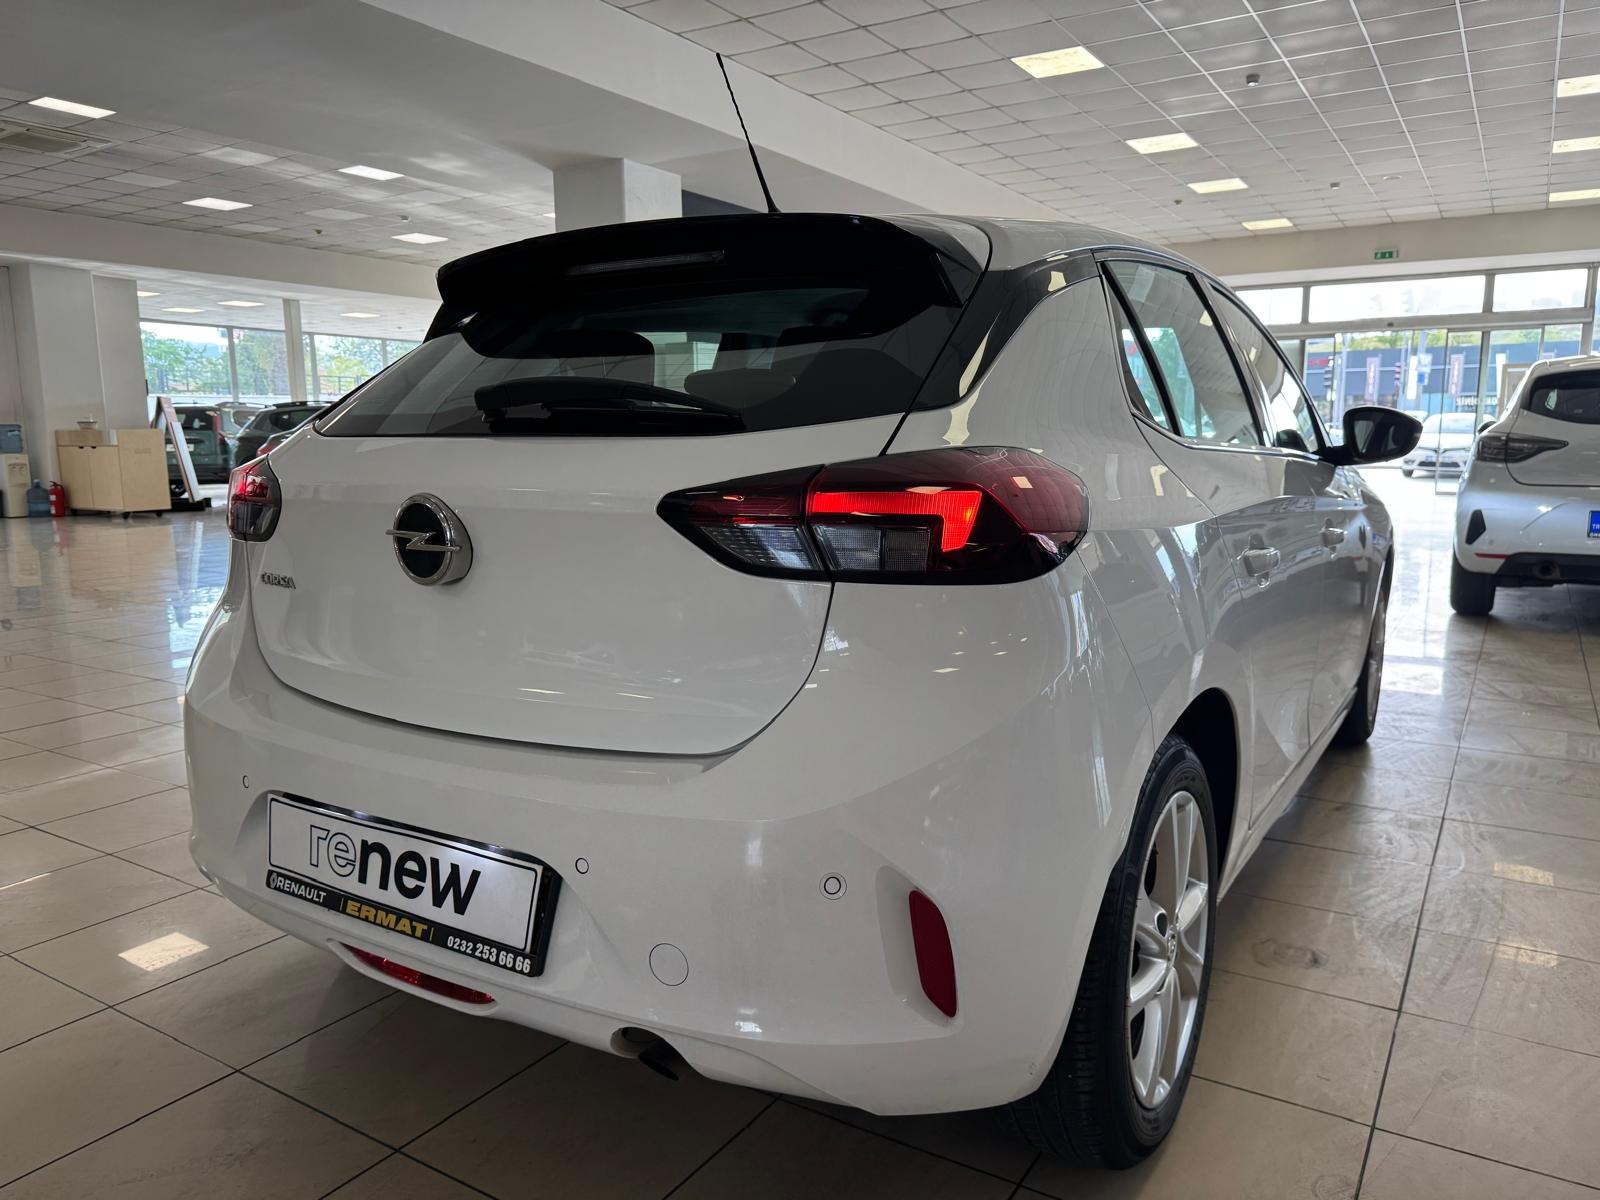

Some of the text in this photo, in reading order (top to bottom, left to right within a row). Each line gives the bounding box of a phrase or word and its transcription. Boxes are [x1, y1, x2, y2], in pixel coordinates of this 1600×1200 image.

[261, 571, 297, 590] CORSA
[309, 824, 481, 916] renew
[276, 876, 327, 903] RENAULT
[345, 900, 427, 938] ERMAT
[447, 936, 531, 974] 0232 253 66 66
